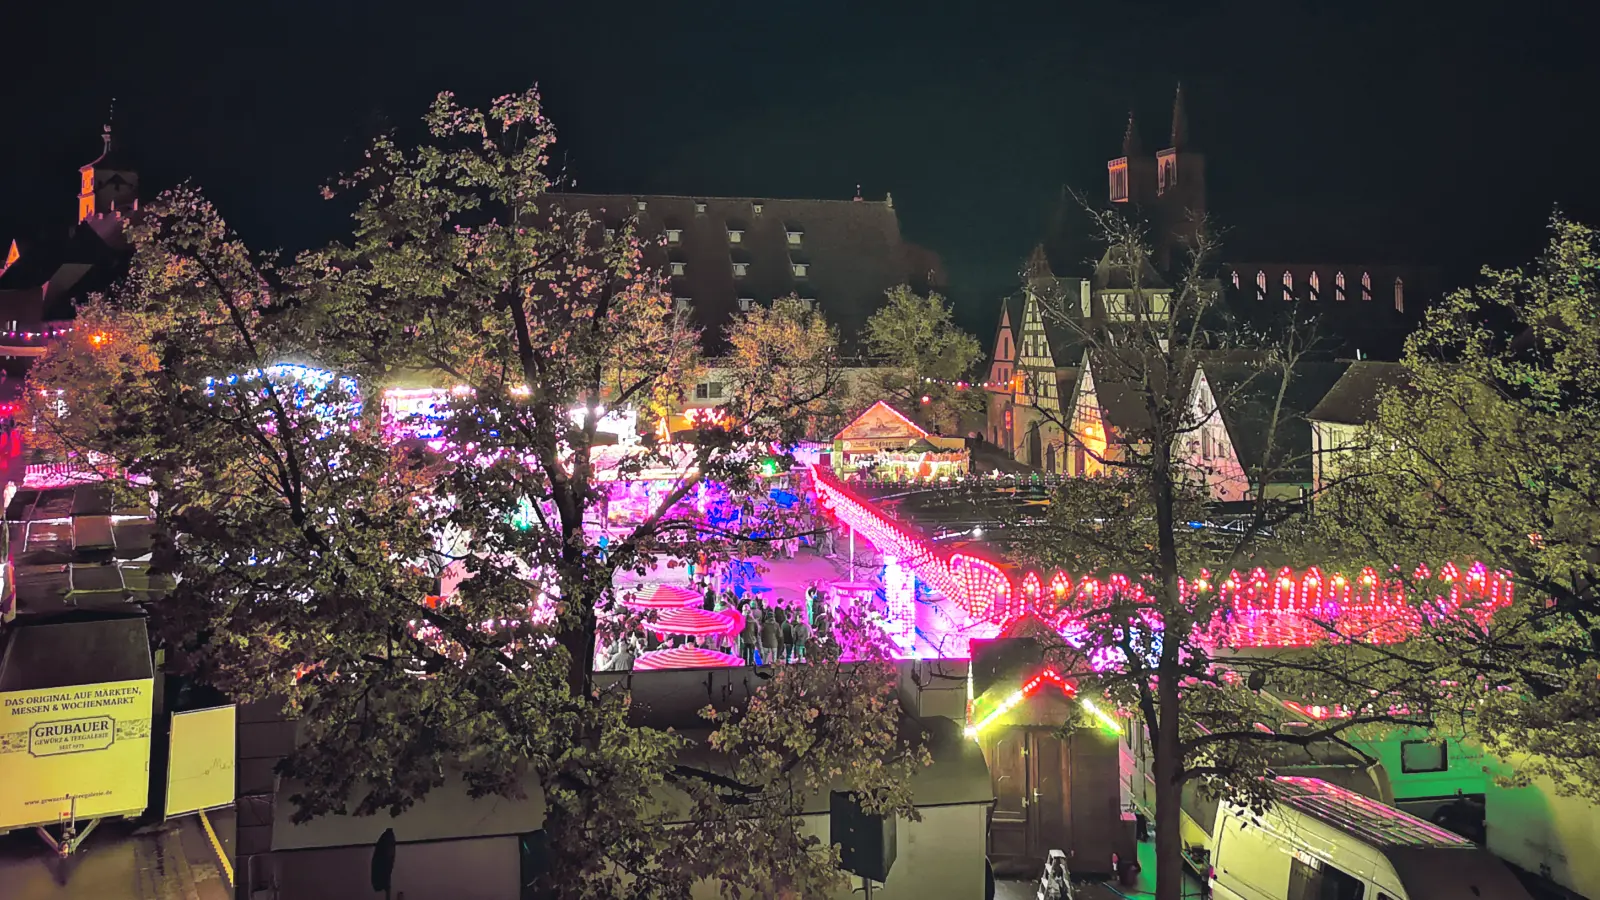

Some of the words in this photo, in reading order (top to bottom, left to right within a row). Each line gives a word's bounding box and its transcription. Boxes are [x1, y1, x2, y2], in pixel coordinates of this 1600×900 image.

[4, 698, 24, 707] DAS
[26, 693, 72, 704] ORIGINAL
[73, 691, 92, 700] AUF
[94, 687, 142, 698] MÄRKTEN,
[11, 705, 50, 716] MESSEN
[61, 697, 135, 710] WOCHENMARKT
[35, 720, 109, 738] GRUBAUER
[34, 736, 62, 746] GEWÜRZ
[71, 732, 109, 742] TEEGALERIE
